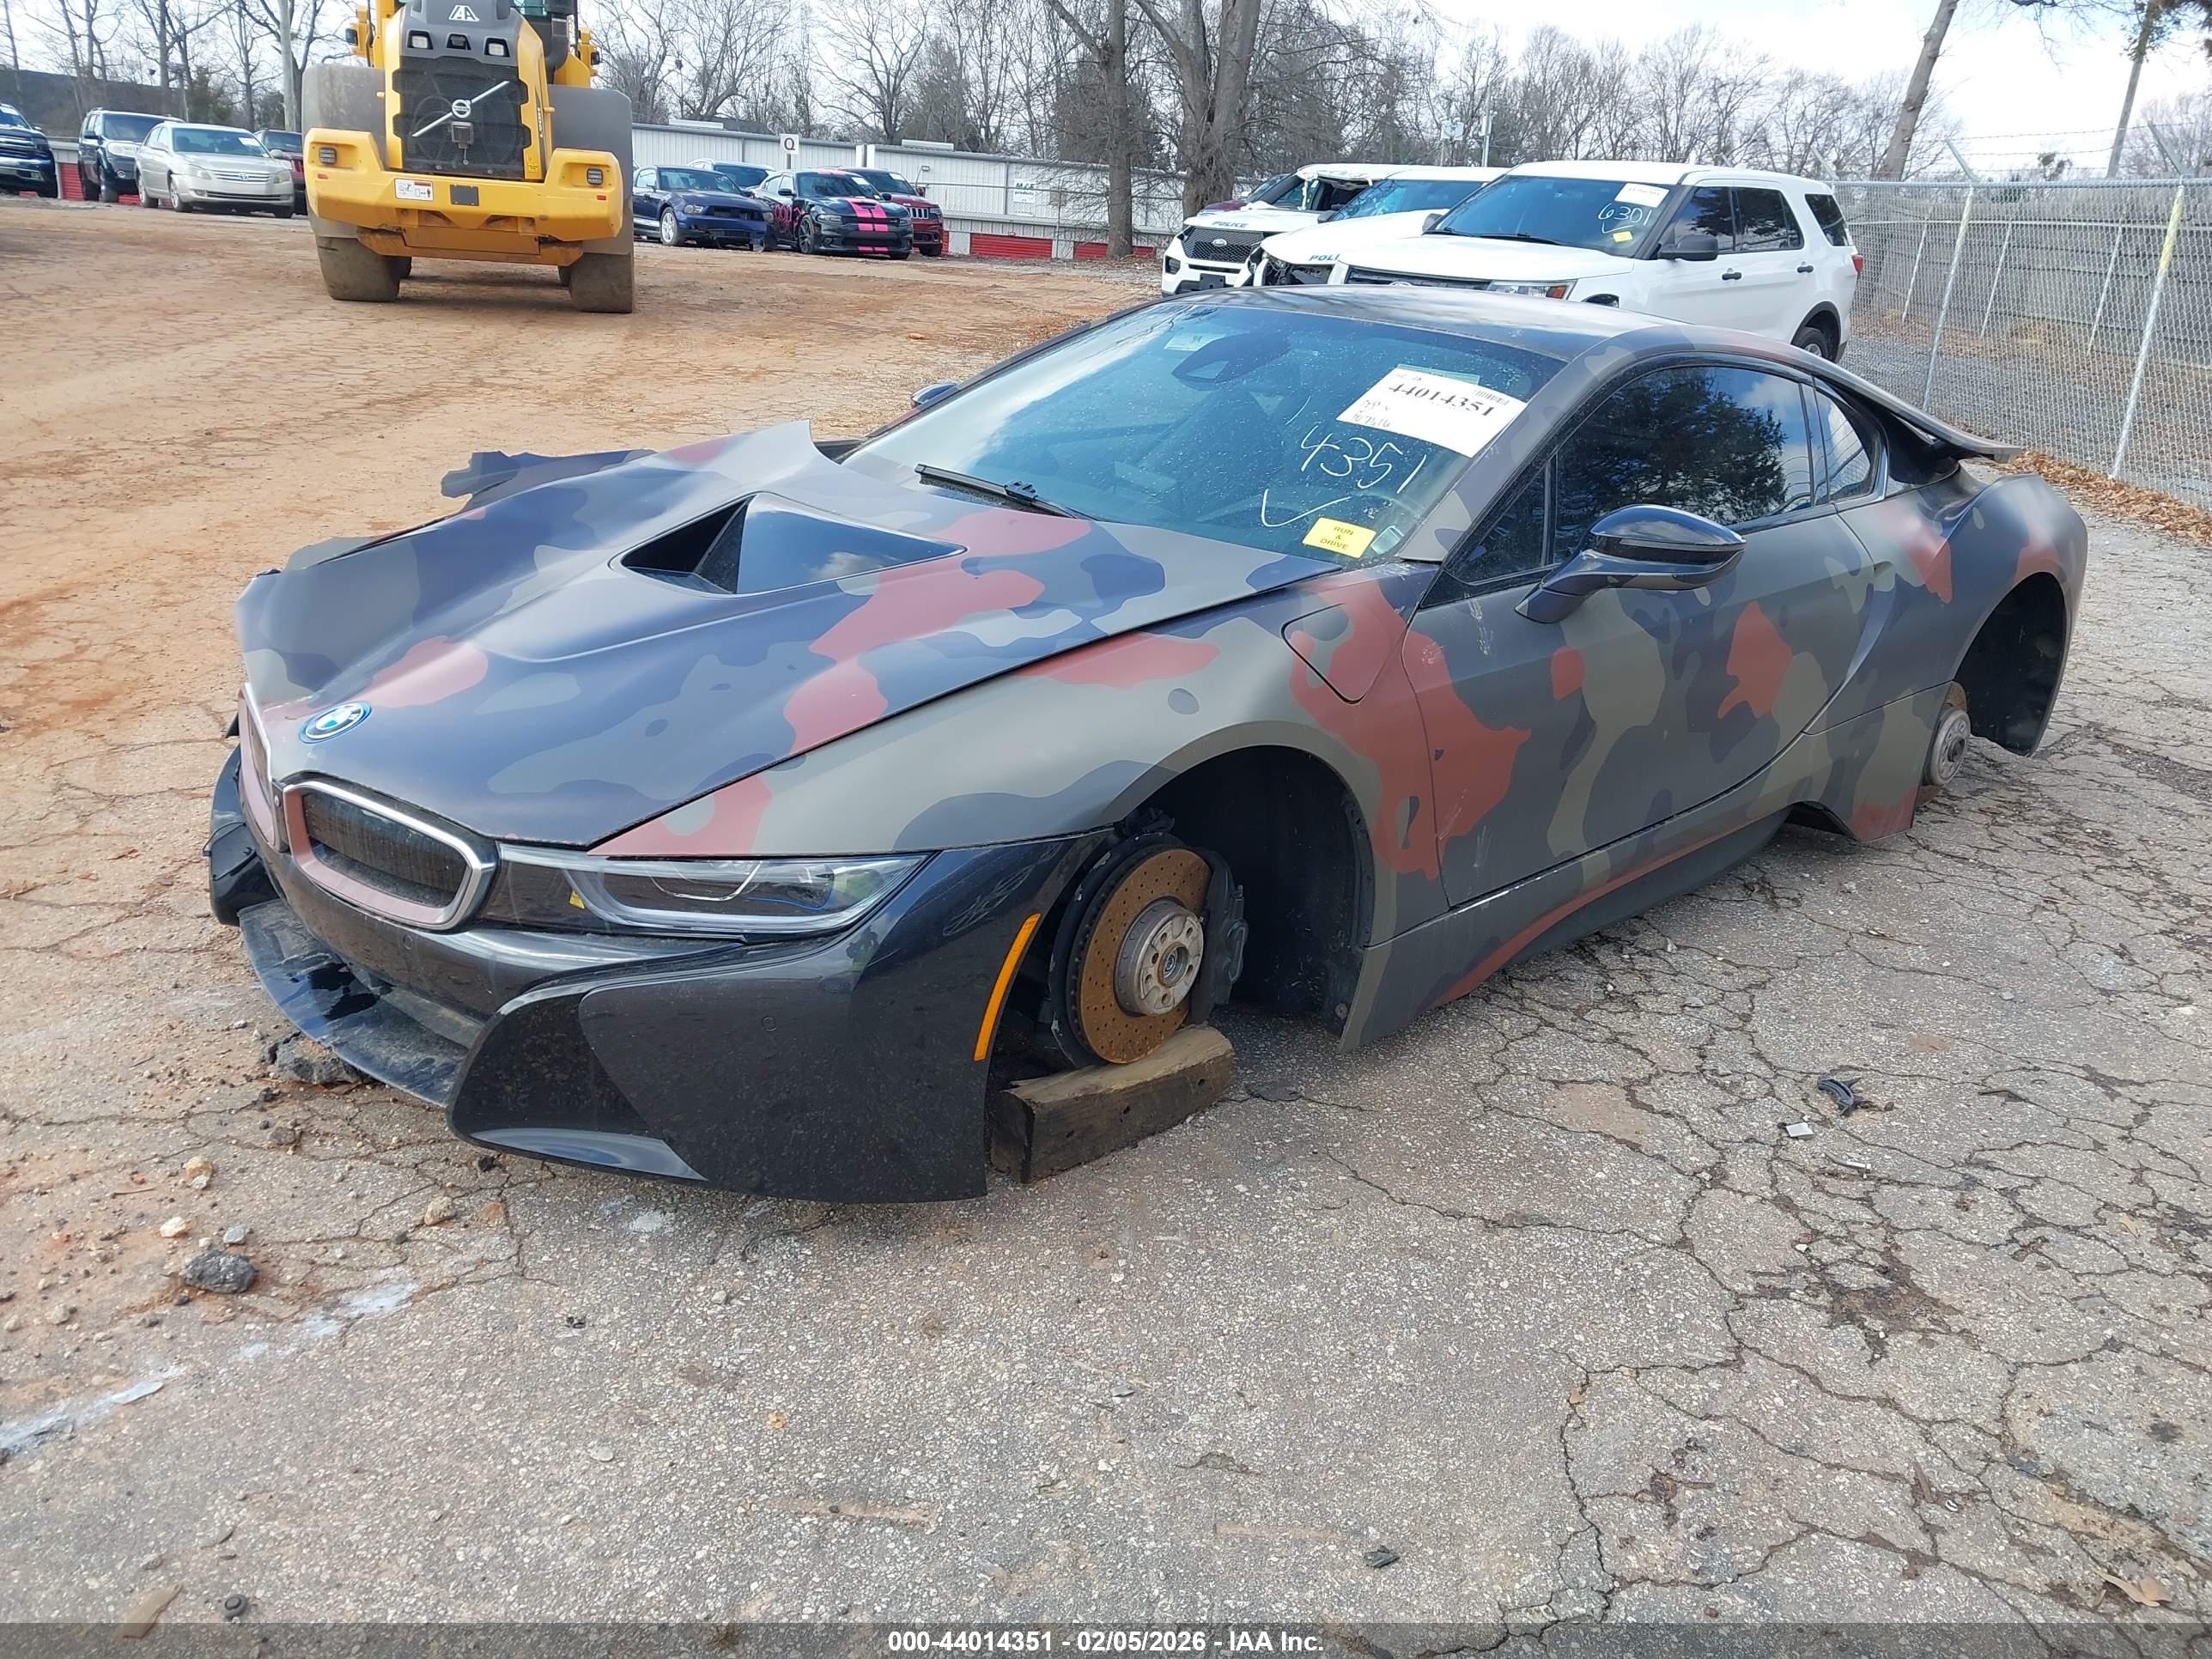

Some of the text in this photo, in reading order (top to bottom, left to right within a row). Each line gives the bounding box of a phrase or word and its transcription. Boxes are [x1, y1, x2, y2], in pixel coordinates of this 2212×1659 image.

[784, 137, 796, 151] Q
[1598, 203, 1652, 226] 6301
[1388, 383, 1495, 416] 44014351
[1301, 425, 1426, 494] 4351
[1333, 526, 1354, 536] RUN
[1320, 538, 1349, 550] DRIVE
